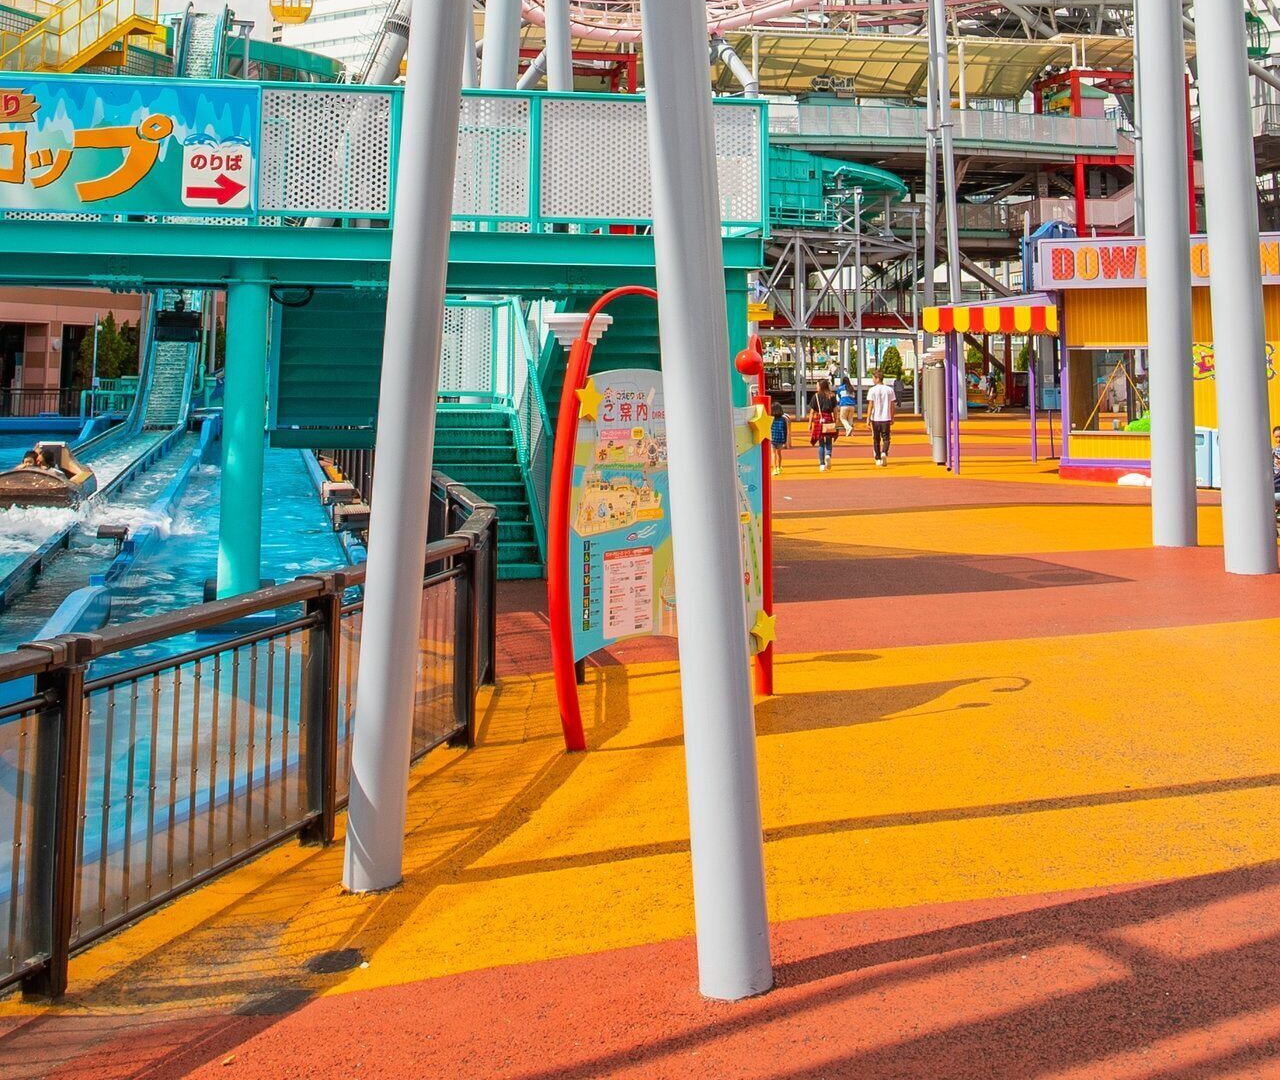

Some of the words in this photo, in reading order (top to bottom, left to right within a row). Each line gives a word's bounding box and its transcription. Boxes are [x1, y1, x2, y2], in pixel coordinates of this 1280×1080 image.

[189, 152, 243, 172] のりば
[1051, 242, 1280, 281] DOWON
[603, 402, 648, 422] ご案内
